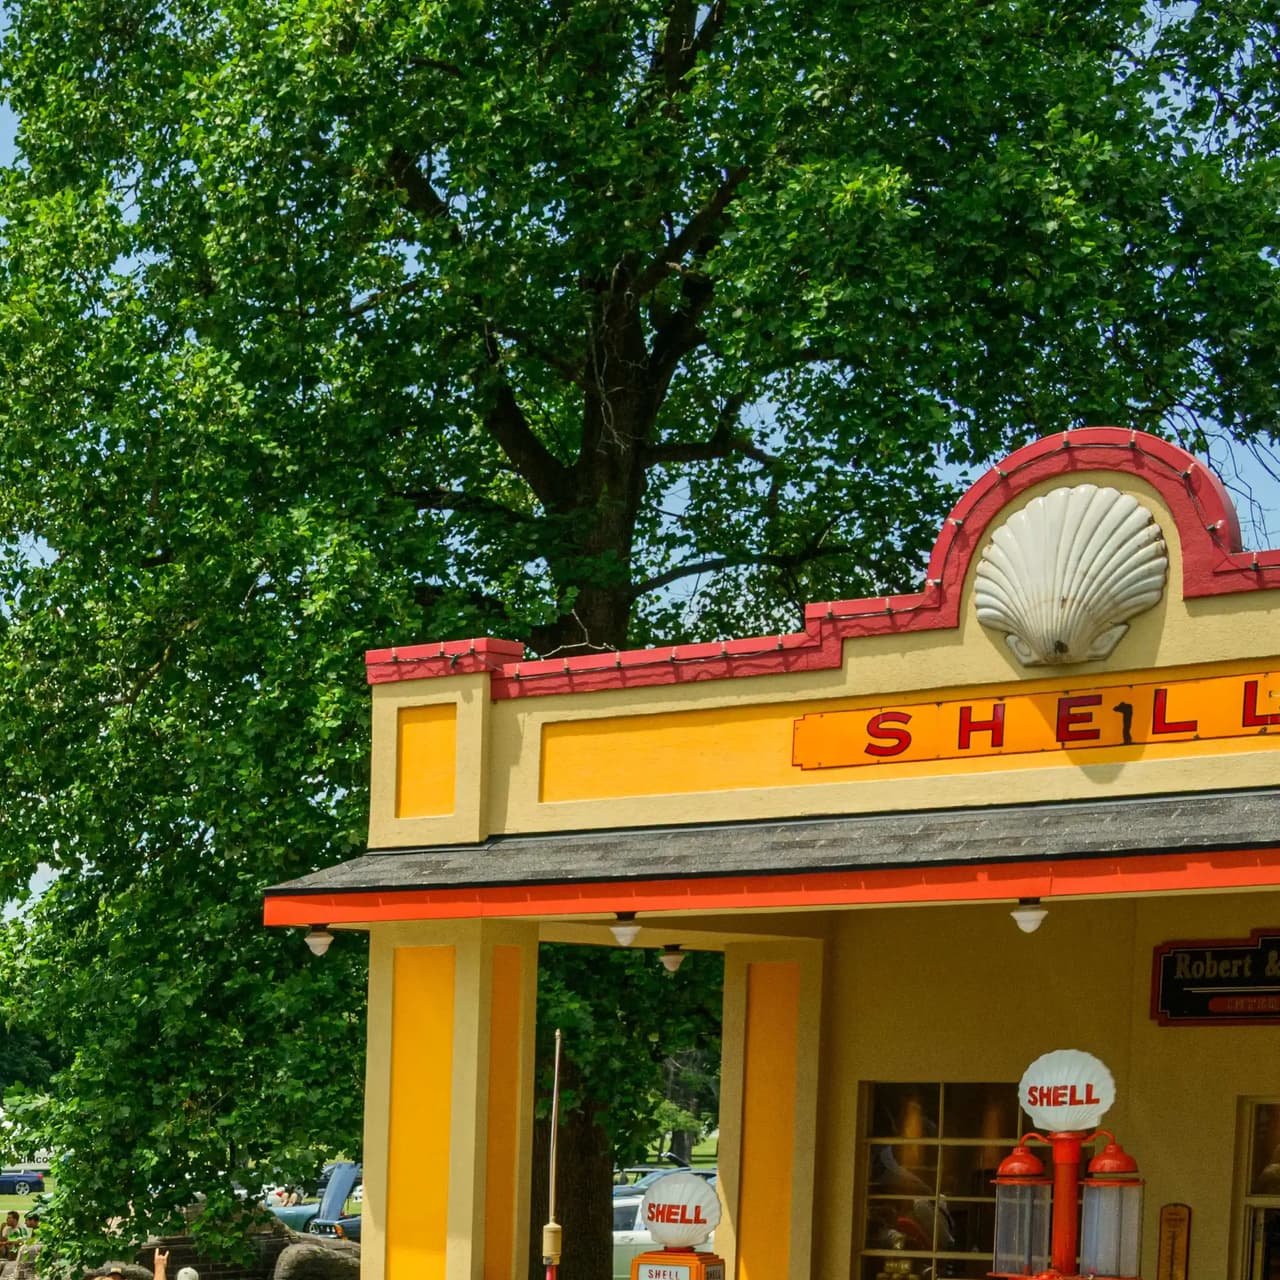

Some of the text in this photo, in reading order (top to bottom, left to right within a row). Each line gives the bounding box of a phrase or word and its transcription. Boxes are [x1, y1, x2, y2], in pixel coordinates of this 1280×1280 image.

[864, 680, 1280, 757] SHELL
[1174, 951, 1253, 979] Robert
[1028, 1084, 1101, 1106] SHELL
[647, 1203, 707, 1224] SHELL
[648, 1269, 680, 1280] SHELL
